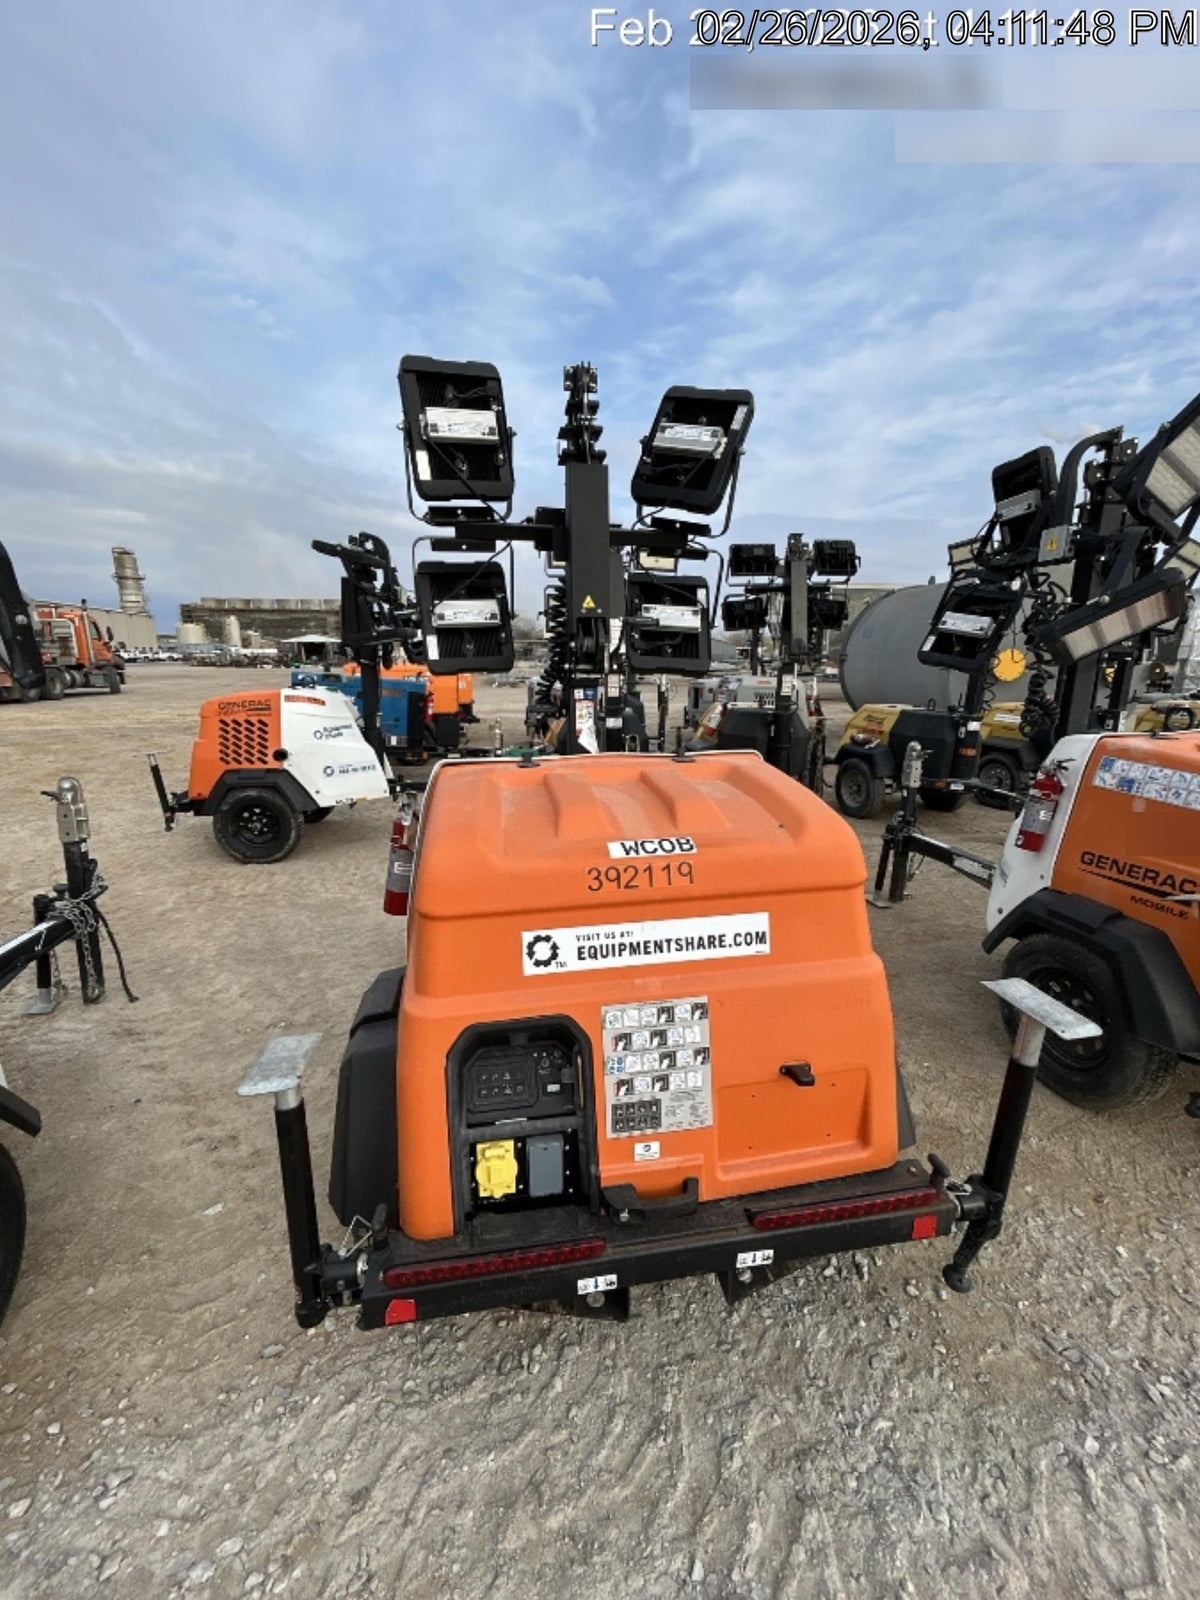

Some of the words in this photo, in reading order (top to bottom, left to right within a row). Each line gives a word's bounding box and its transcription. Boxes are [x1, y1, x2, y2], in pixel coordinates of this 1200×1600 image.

[587, 861, 694, 892] 392119
[1080, 850, 1198, 895] GENERAC
[1130, 895, 1189, 920] MOBILE
[575, 932, 601, 942] VISIT
[604, 930, 616, 940] US
[576, 930, 768, 961] EQUIPMENTSHARE.COM
